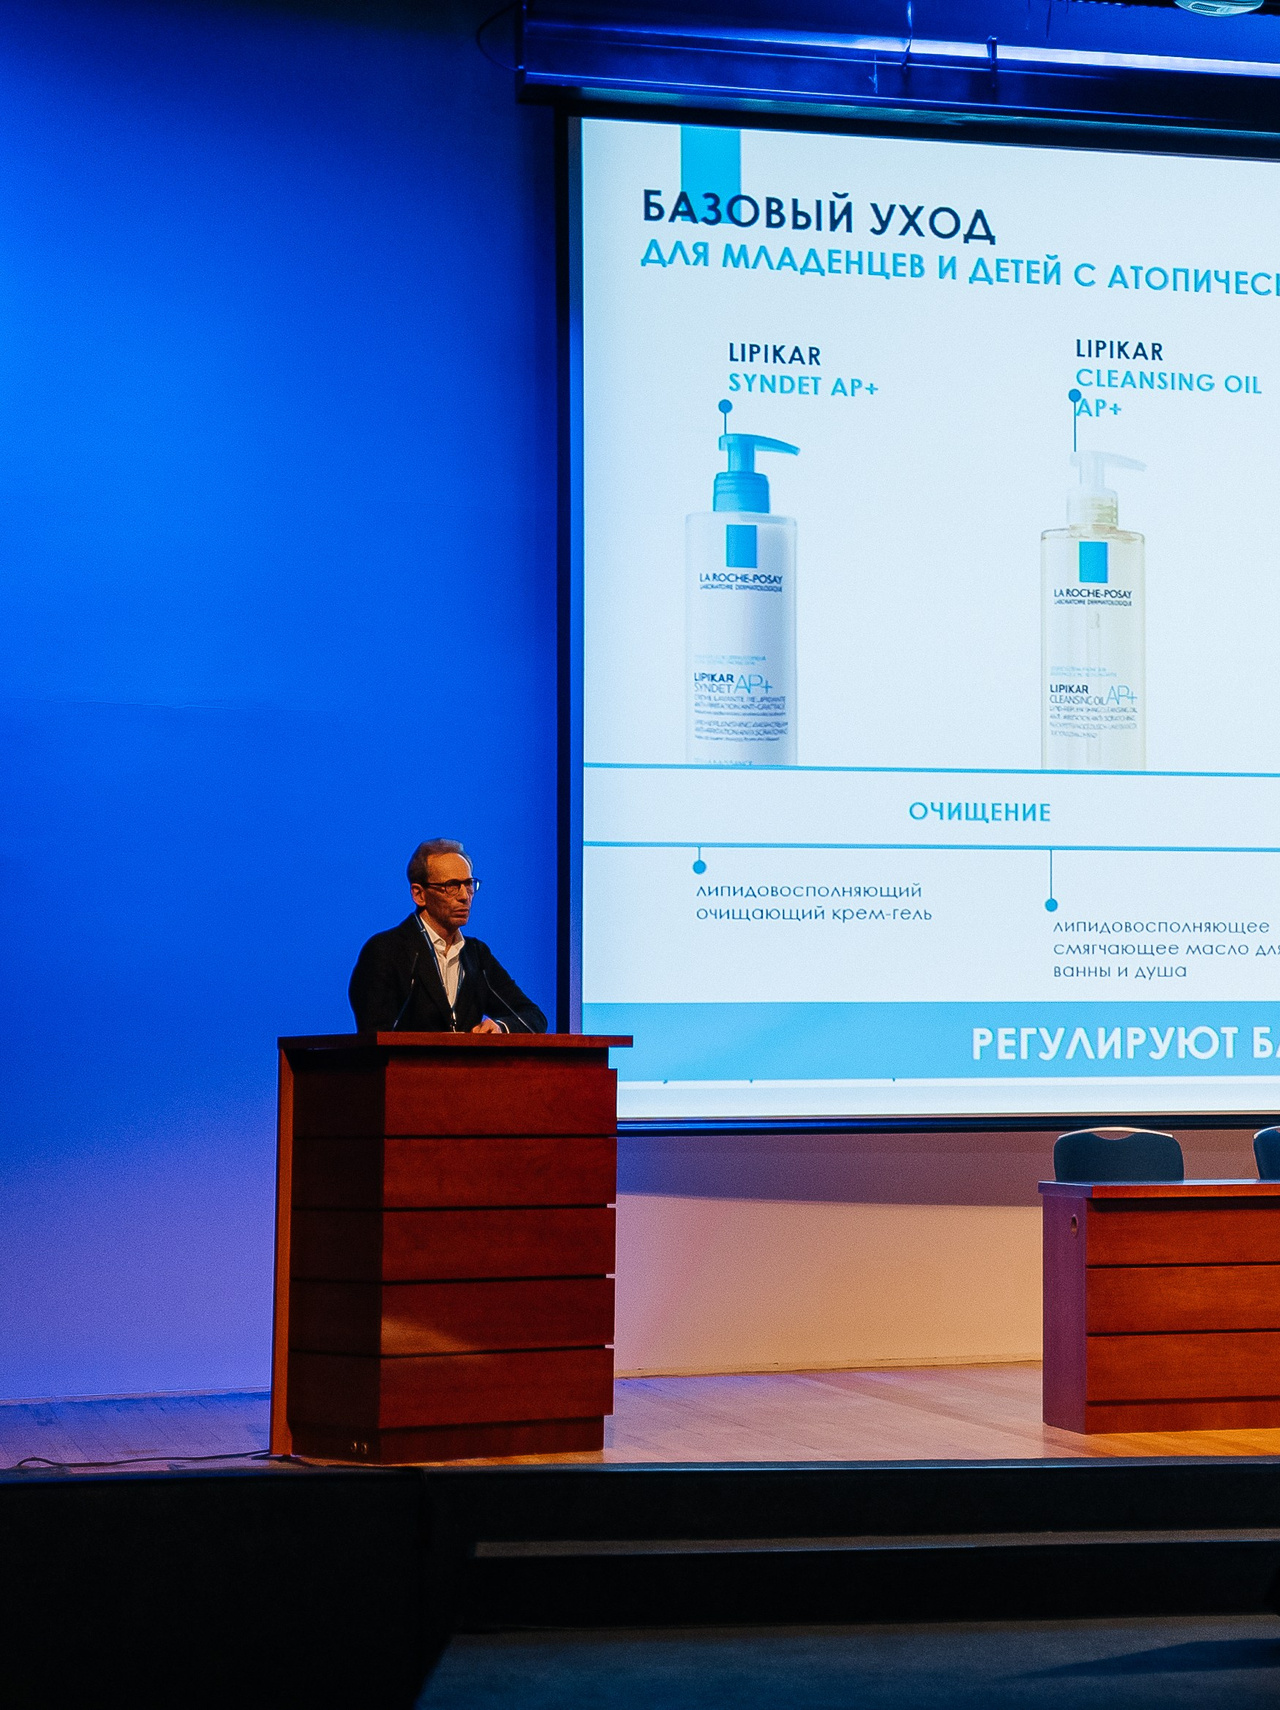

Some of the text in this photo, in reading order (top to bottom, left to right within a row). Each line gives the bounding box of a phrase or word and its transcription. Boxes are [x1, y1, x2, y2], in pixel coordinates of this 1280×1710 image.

[643, 189, 996, 245] БАЗОВЫЙ УХОД
[640, 239, 709, 267] ДЛЯ
[722, 242, 925, 280] МЛАДЕНЦЕВ
[939, 256, 957, 280] И
[969, 254, 1062, 286] ДЕТЕЙ
[1074, 263, 1096, 287] С
[729, 343, 821, 366] LIPIKAR
[1075, 339, 1164, 361] LIPIKAR
[729, 373, 879, 397] SYNDET AP+
[1075, 369, 1262, 395] CLEANSING OIL
[1076, 399, 1122, 418] AP+
[699, 573, 783, 585] LA ROCHE-POSAY
[1054, 588, 1132, 599] LA ROCHE-POSAY
[694, 672, 734, 683] LIPIKAR
[694, 674, 773, 694] SYNDET AP+
[1049, 684, 1089, 694] LIPIKAR
[1049, 694, 1092, 705] CLEANSING
[909, 801, 1051, 822] ОЧИЩЕНИЕ
[696, 883, 922, 899] липидовосполняющий
[696, 905, 932, 923] очищающий крем-гель
[1053, 921, 1270, 934] липидовосполняющее
[1053, 943, 1179, 956] смягчающее
[1186, 943, 1249, 955] масло
[1053, 966, 1187, 980] ванны и душа
[972, 1026, 1238, 1060] РЕГУЛИРУЮТ
